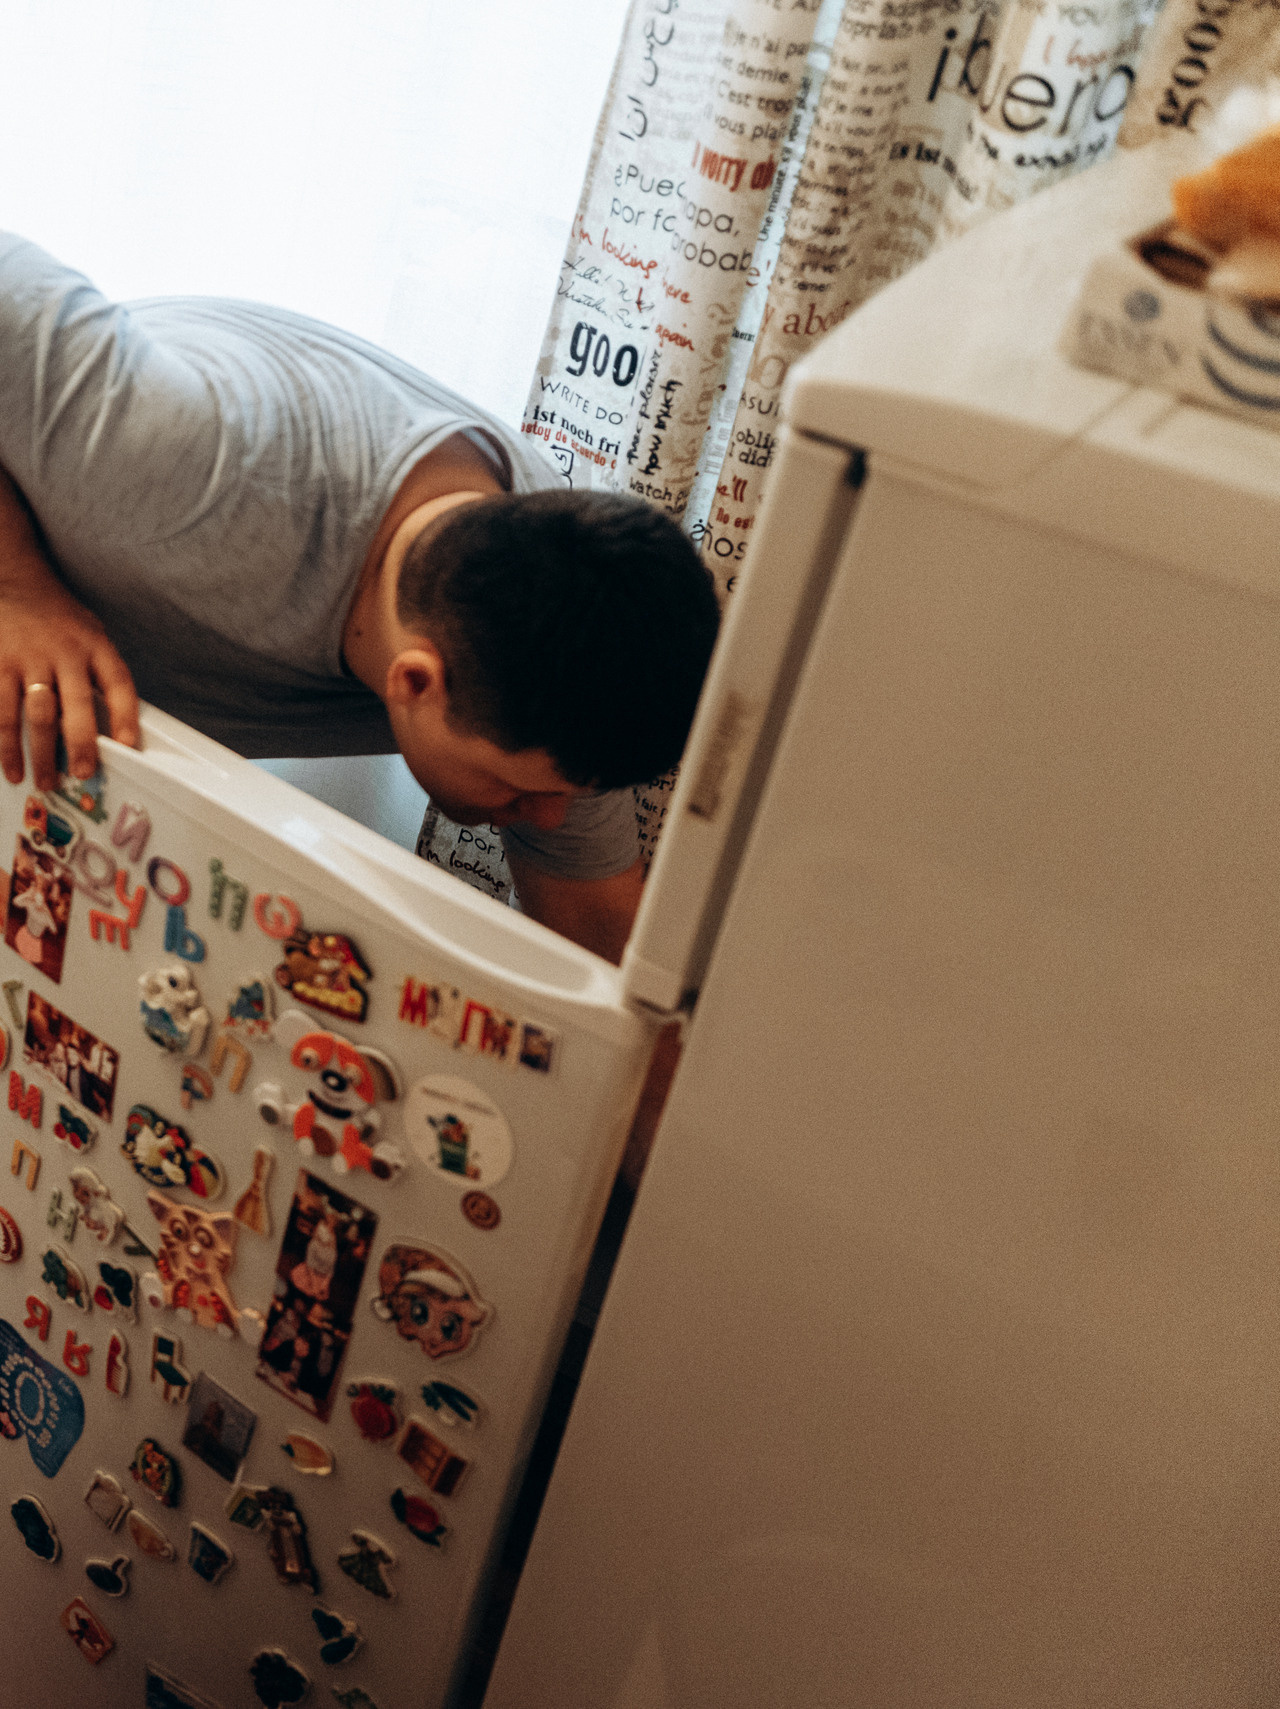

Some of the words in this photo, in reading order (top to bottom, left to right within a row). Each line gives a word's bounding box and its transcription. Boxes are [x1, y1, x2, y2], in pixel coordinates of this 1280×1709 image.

[610, 197, 646, 226] por
[601, 227, 658, 280] looking
[539, 374, 590, 414] WRITE
[533, 404, 557, 424] ist
[560, 415, 595, 447] noch
[555, 430, 568, 444] de
[571, 440, 607, 468] acuerdo
[629, 476, 673, 503] watch
[457, 827, 497, 855] por
[449, 849, 506, 893] looking
